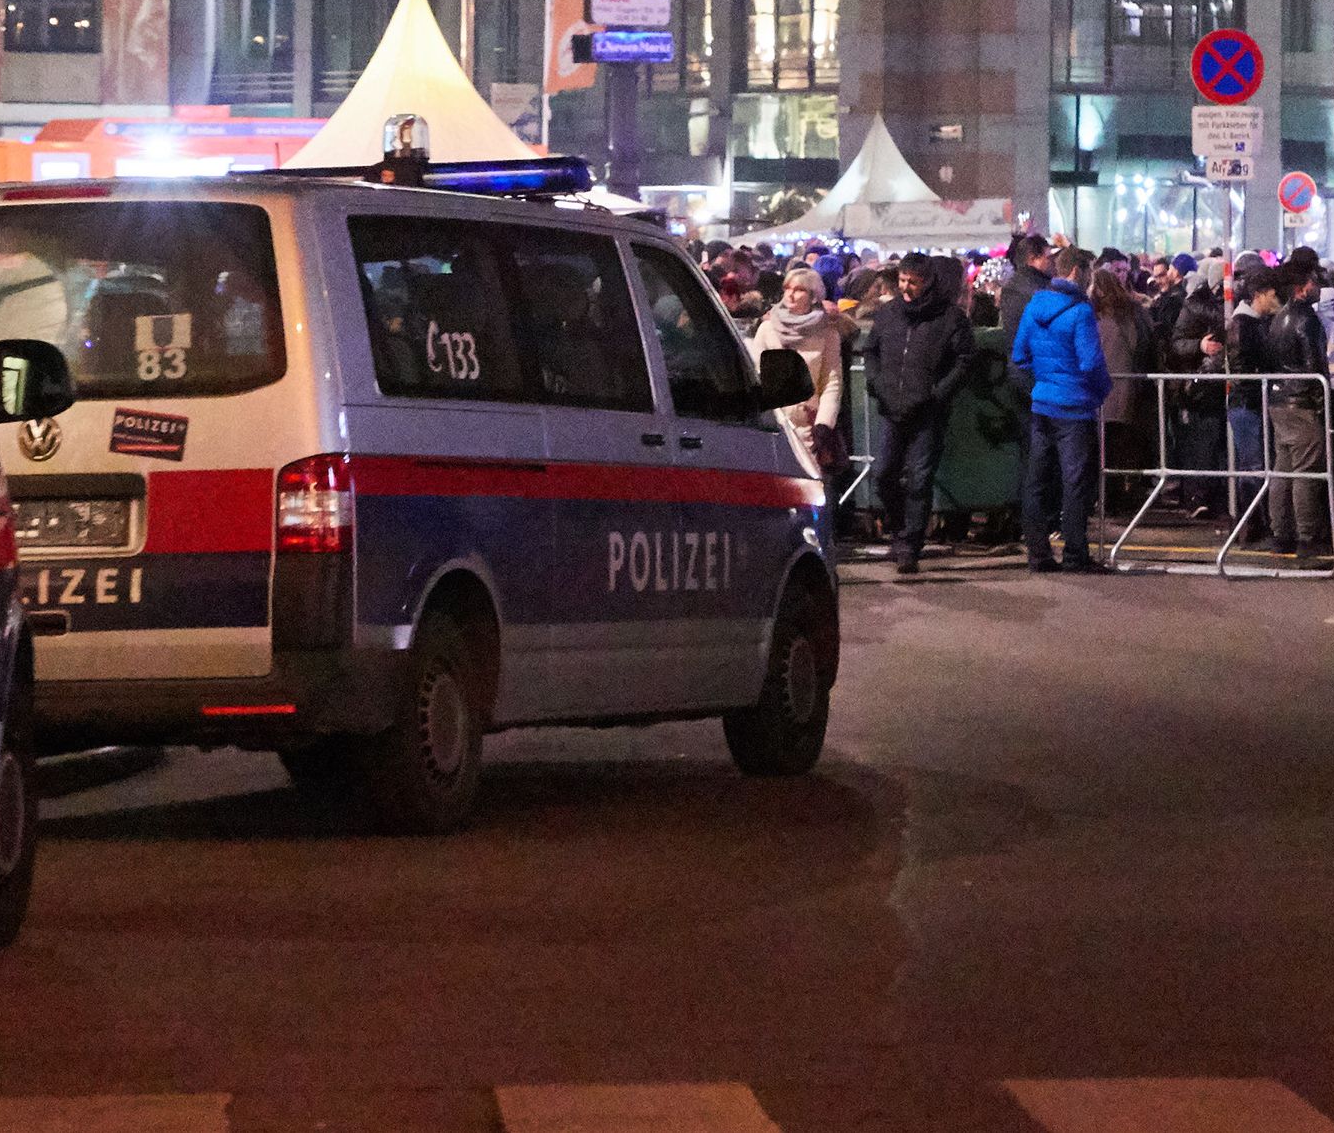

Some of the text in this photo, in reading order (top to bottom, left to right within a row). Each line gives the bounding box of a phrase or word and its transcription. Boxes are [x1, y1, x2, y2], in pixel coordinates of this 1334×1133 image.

[136, 349, 188, 381] 83
[437, 332, 480, 380] 133
[114, 415, 176, 433] POLIZEI
[607, 531, 730, 592] POLIZEI
